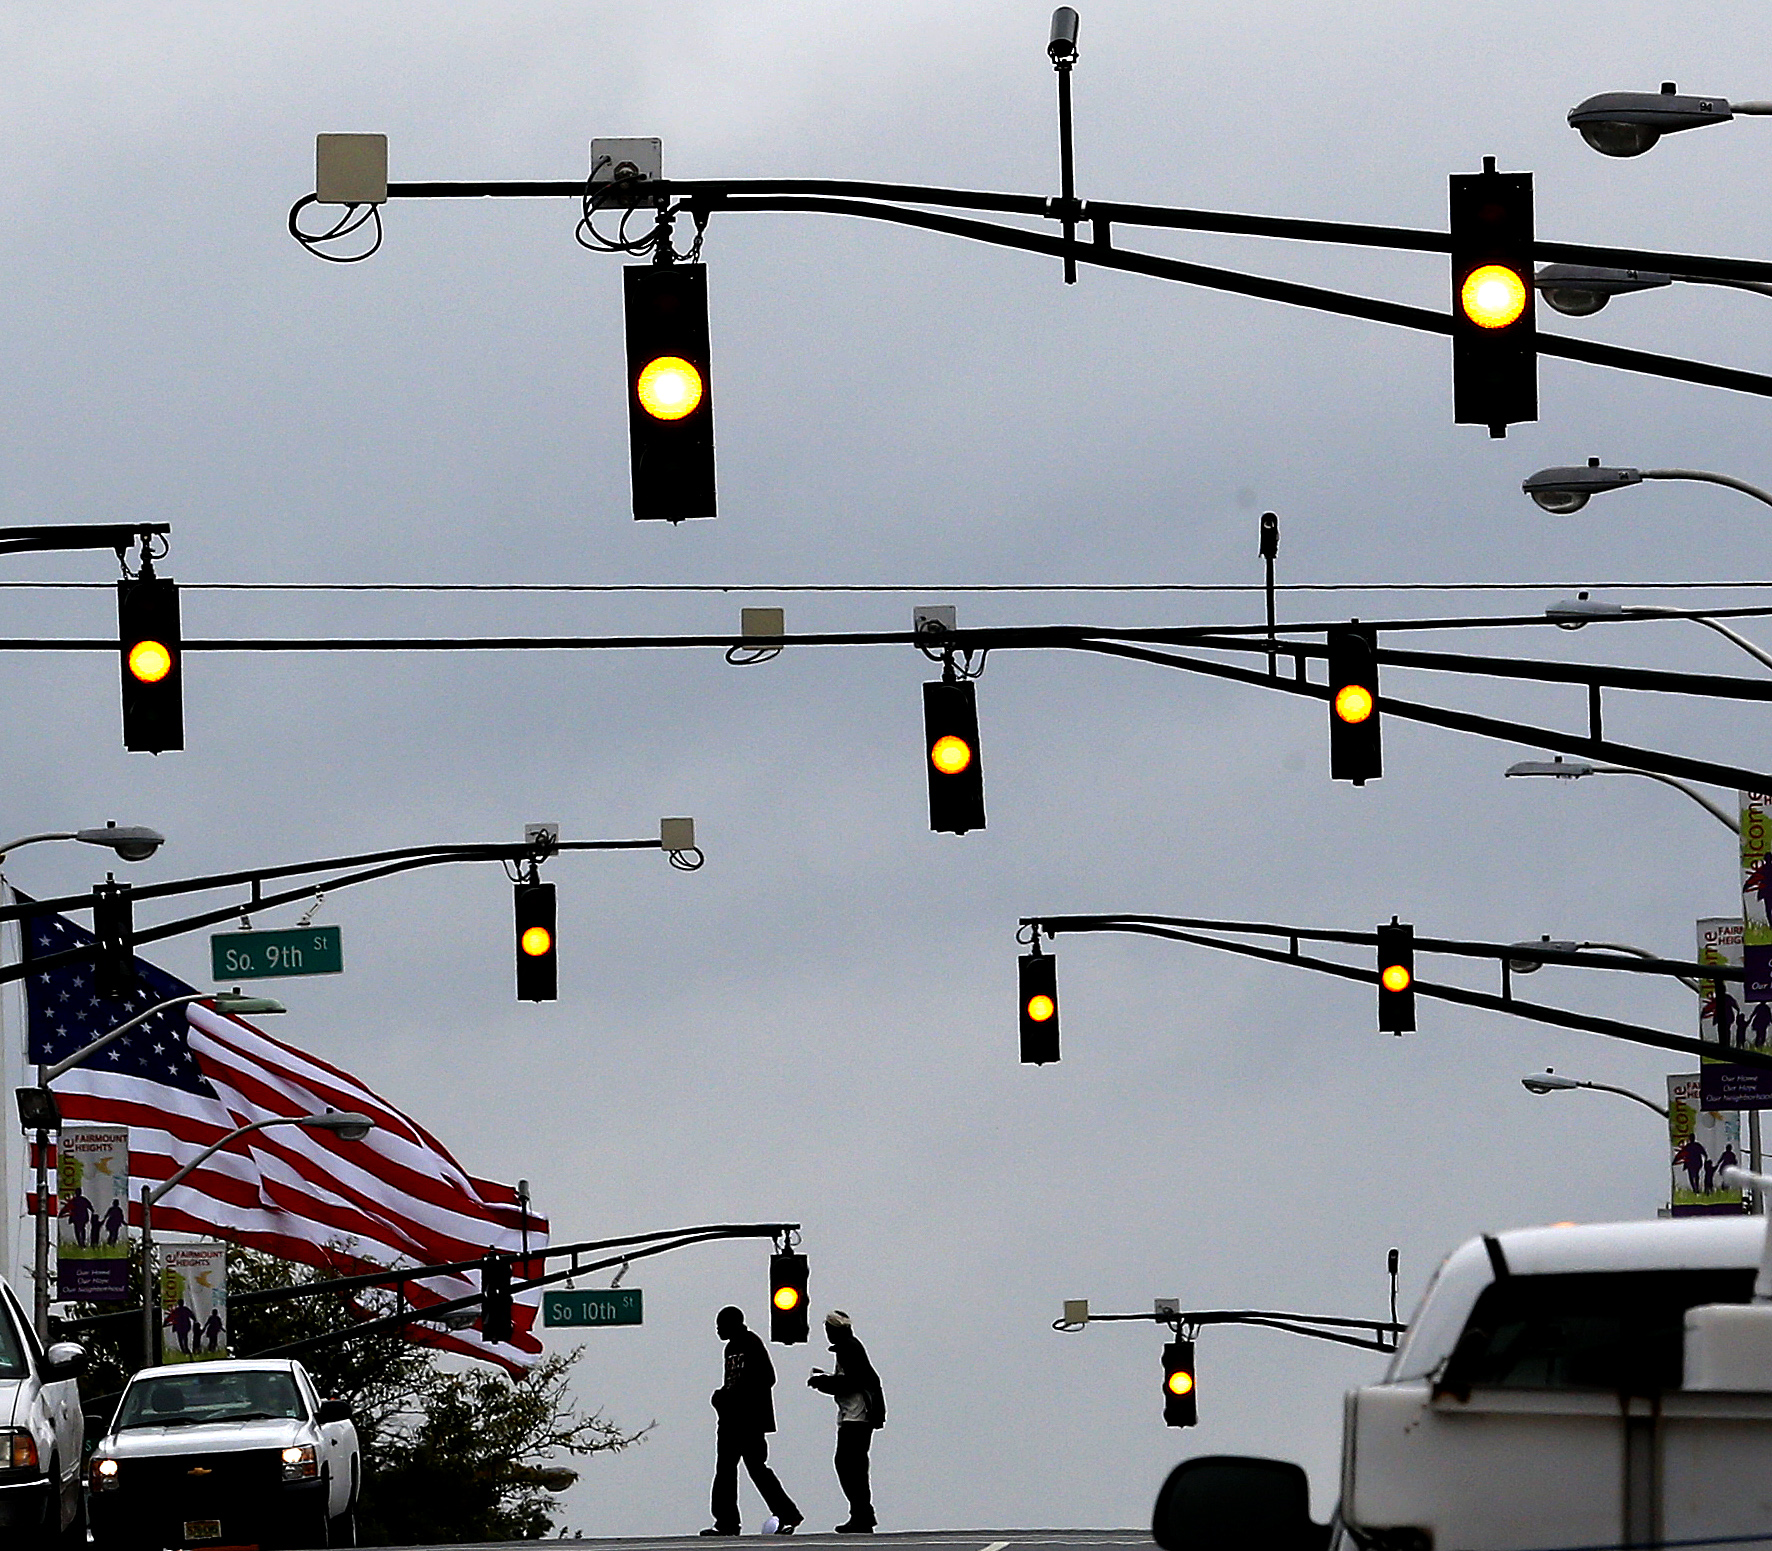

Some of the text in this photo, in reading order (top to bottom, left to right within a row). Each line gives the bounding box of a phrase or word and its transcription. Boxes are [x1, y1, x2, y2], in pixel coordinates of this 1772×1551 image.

[225, 936, 328, 972] So. 9th St
[75, 1133, 127, 1143] FAIRMOUNT
[75, 1143, 113, 1153] HEIGHTS
[176, 1251, 223, 1259] FAIRMOUNT
[176, 1259, 211, 1267] HEIGHTS
[552, 1296, 634, 1320] So 10th St
